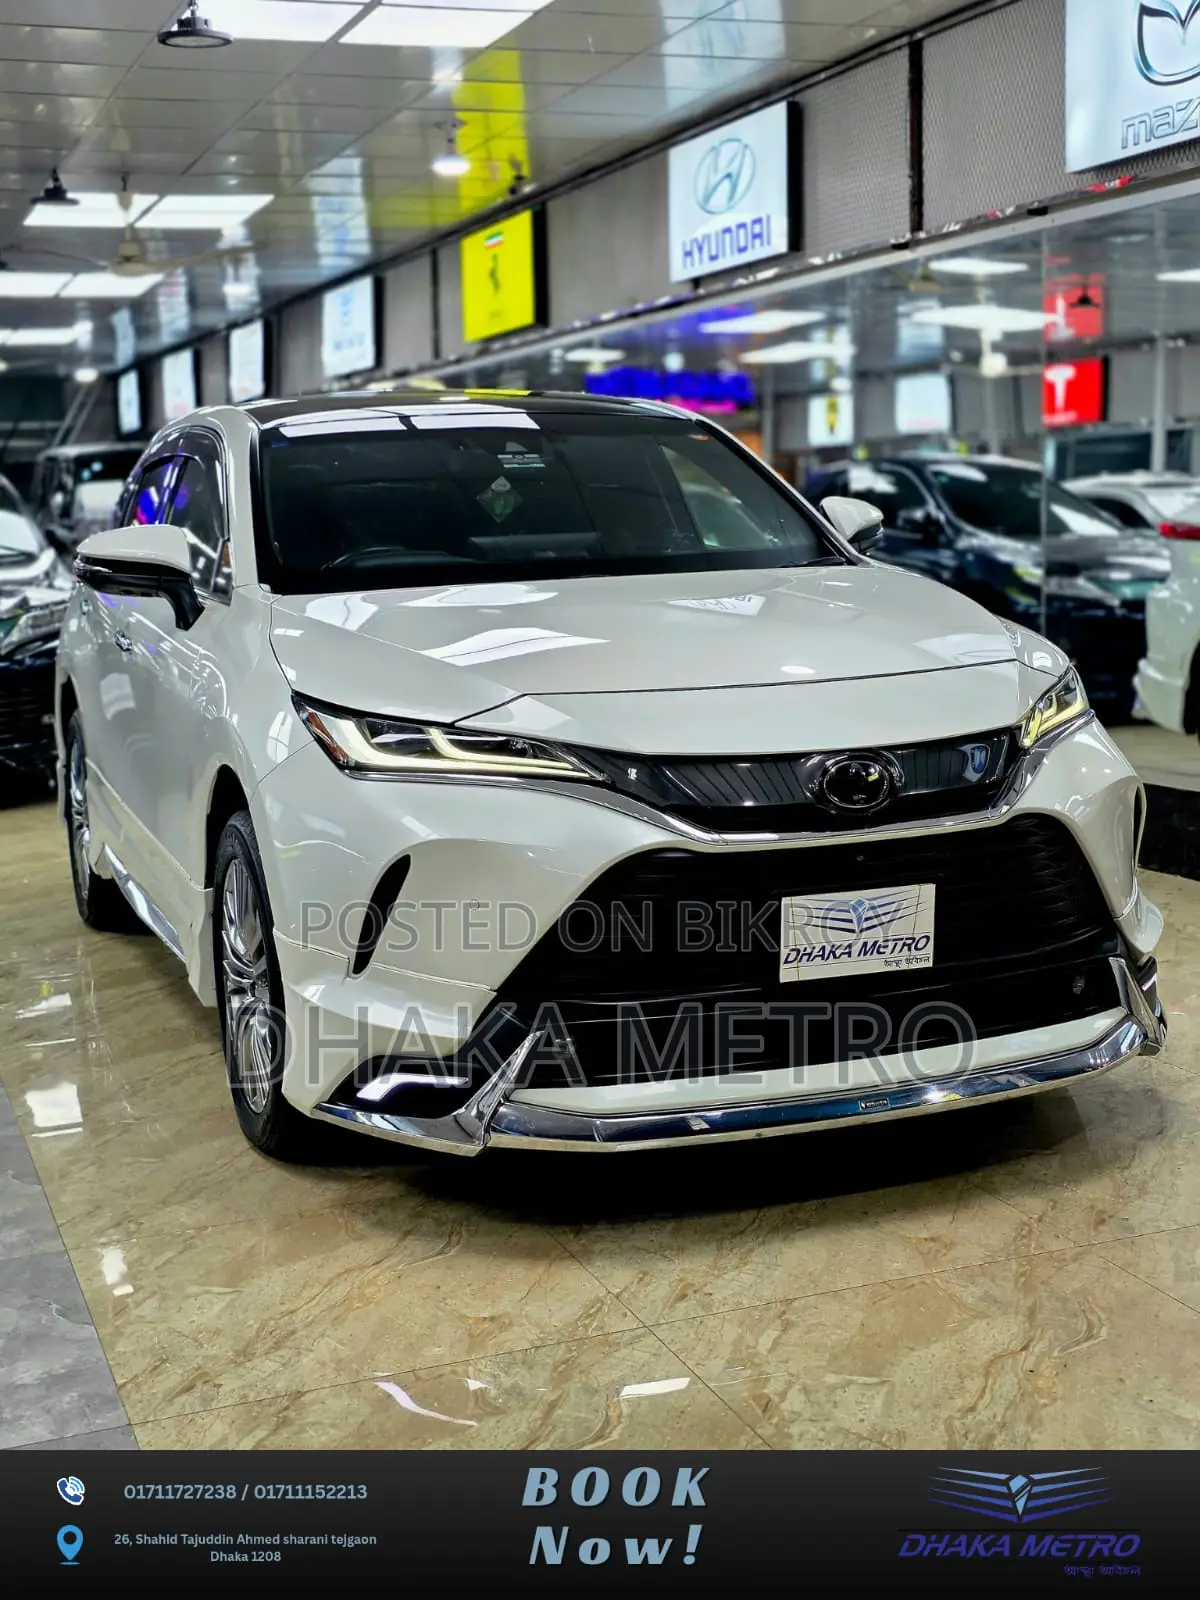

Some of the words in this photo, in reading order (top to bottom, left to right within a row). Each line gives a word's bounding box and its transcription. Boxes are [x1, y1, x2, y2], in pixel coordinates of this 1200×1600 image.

[1121, 97, 1200, 150] maz
[682, 213, 771, 269] HYUNDAI
[783, 943, 851, 965] DHAKA
[857, 934, 931, 957] METRO
